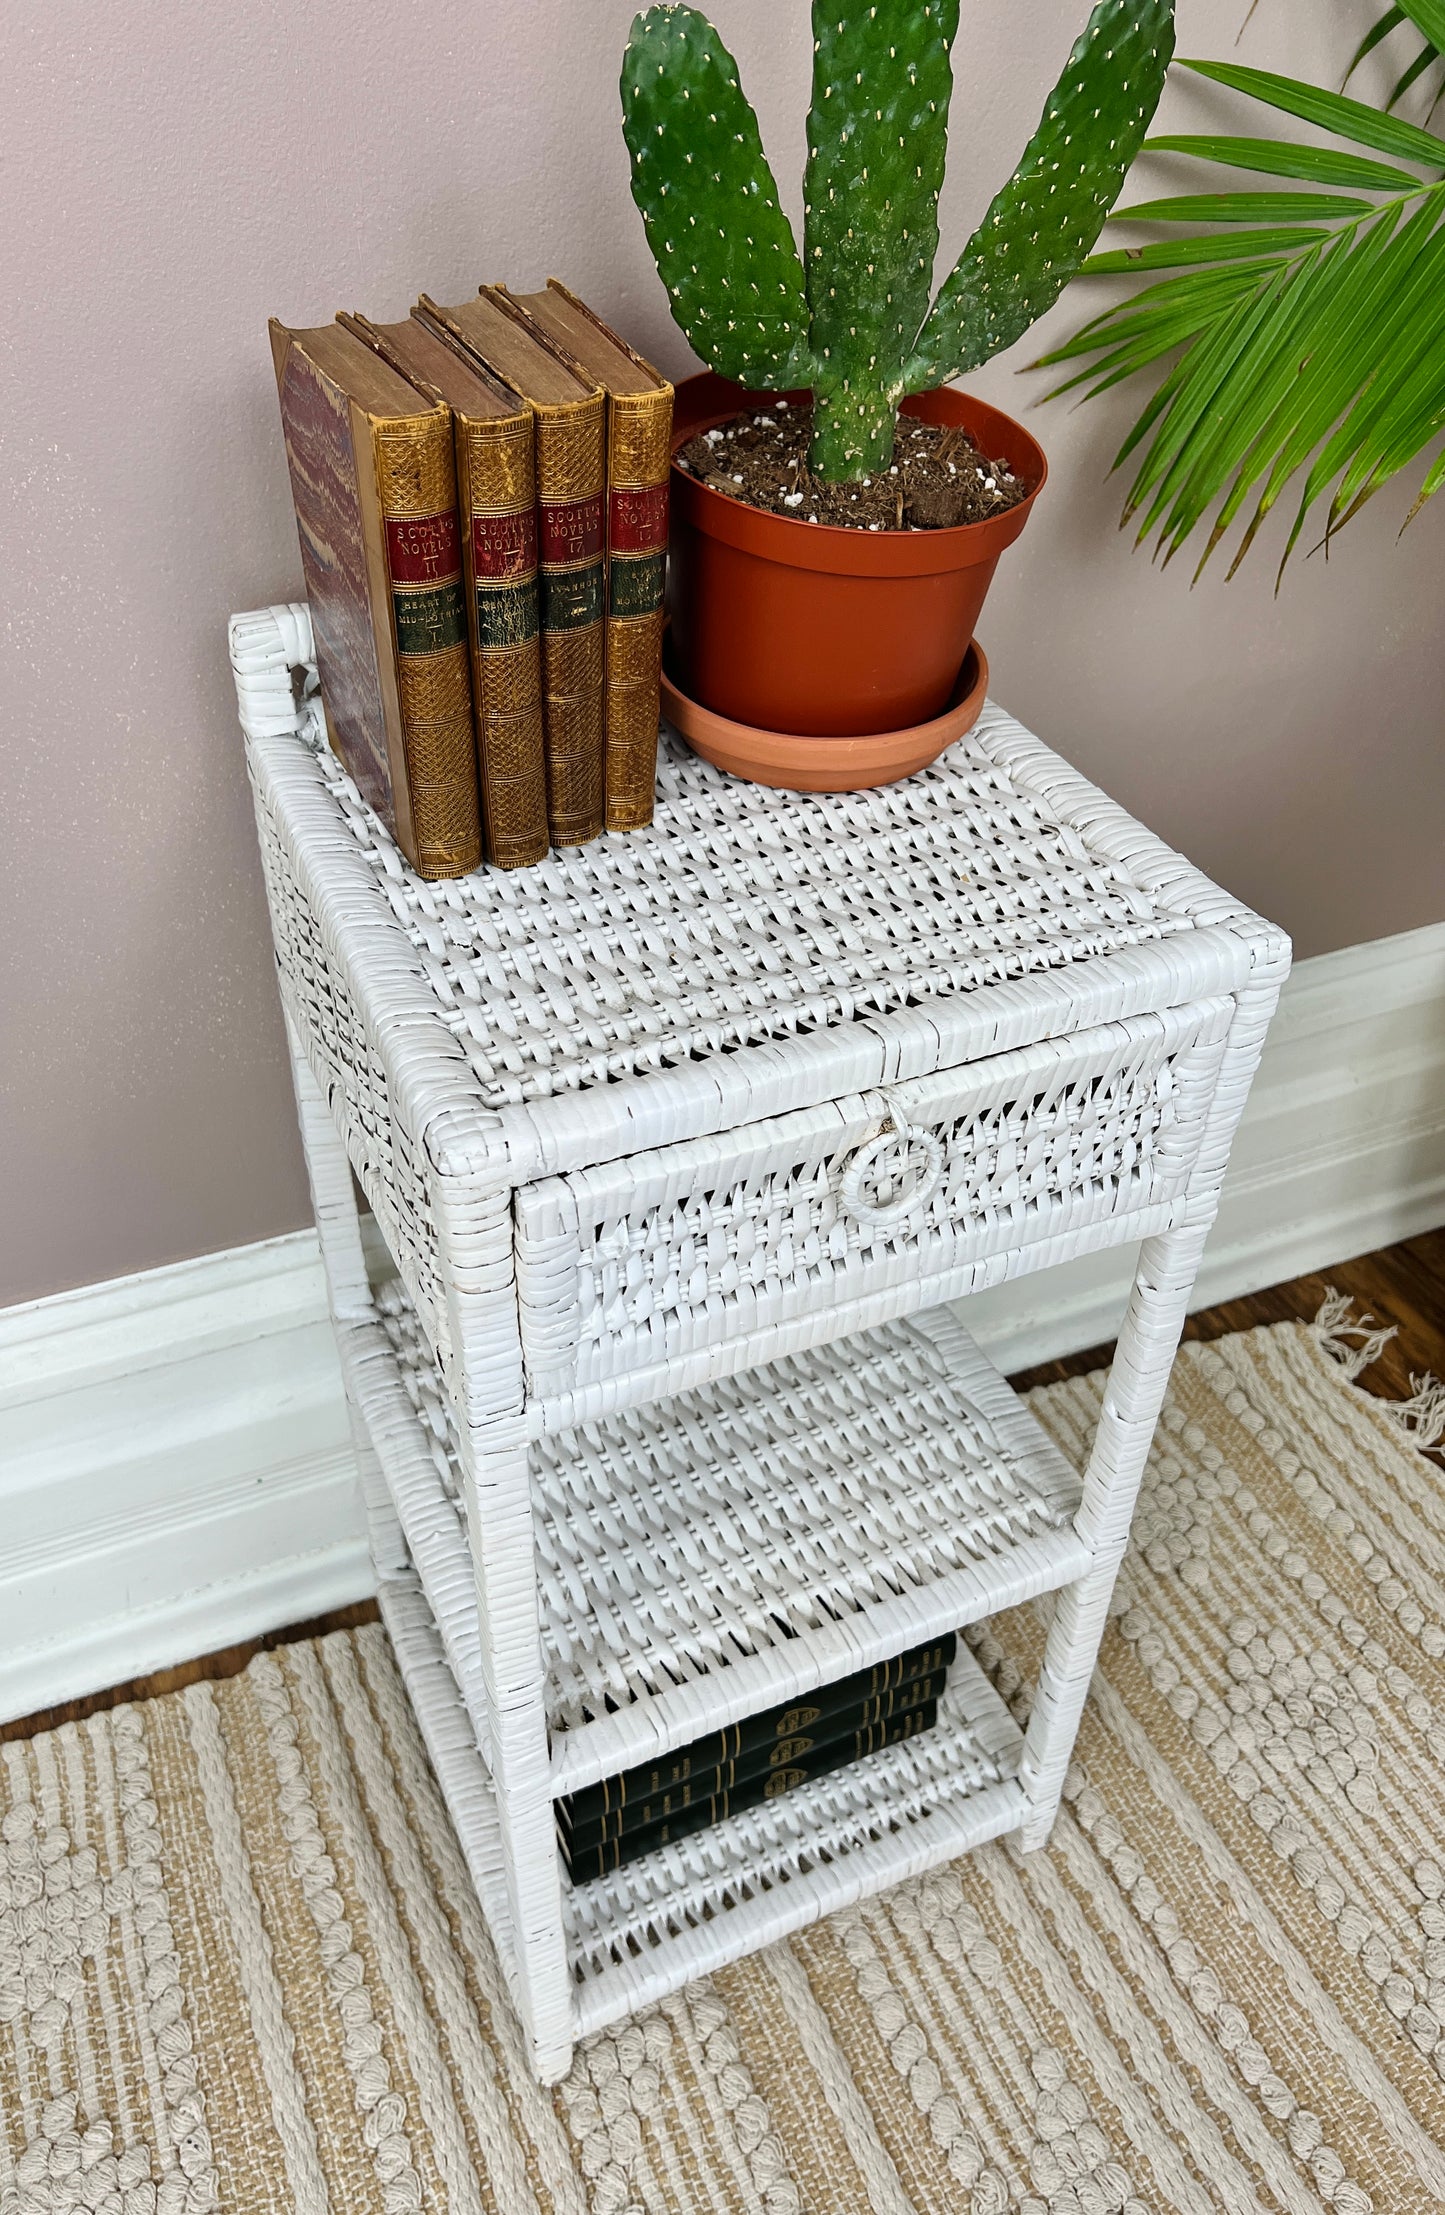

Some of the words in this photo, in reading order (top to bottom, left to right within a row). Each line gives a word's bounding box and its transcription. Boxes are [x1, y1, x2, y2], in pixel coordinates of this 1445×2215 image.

[547, 502, 600, 523] SCOTT'S
[397, 518, 454, 539] SCOTT'S
[550, 519, 598, 538] NOVELS
[401, 537, 452, 555] NOVELS
[484, 532, 534, 551] NOVELS
[569, 541, 583, 553] 17
[550, 577, 598, 593] IVANHOE
[403, 598, 440, 610] HEART
